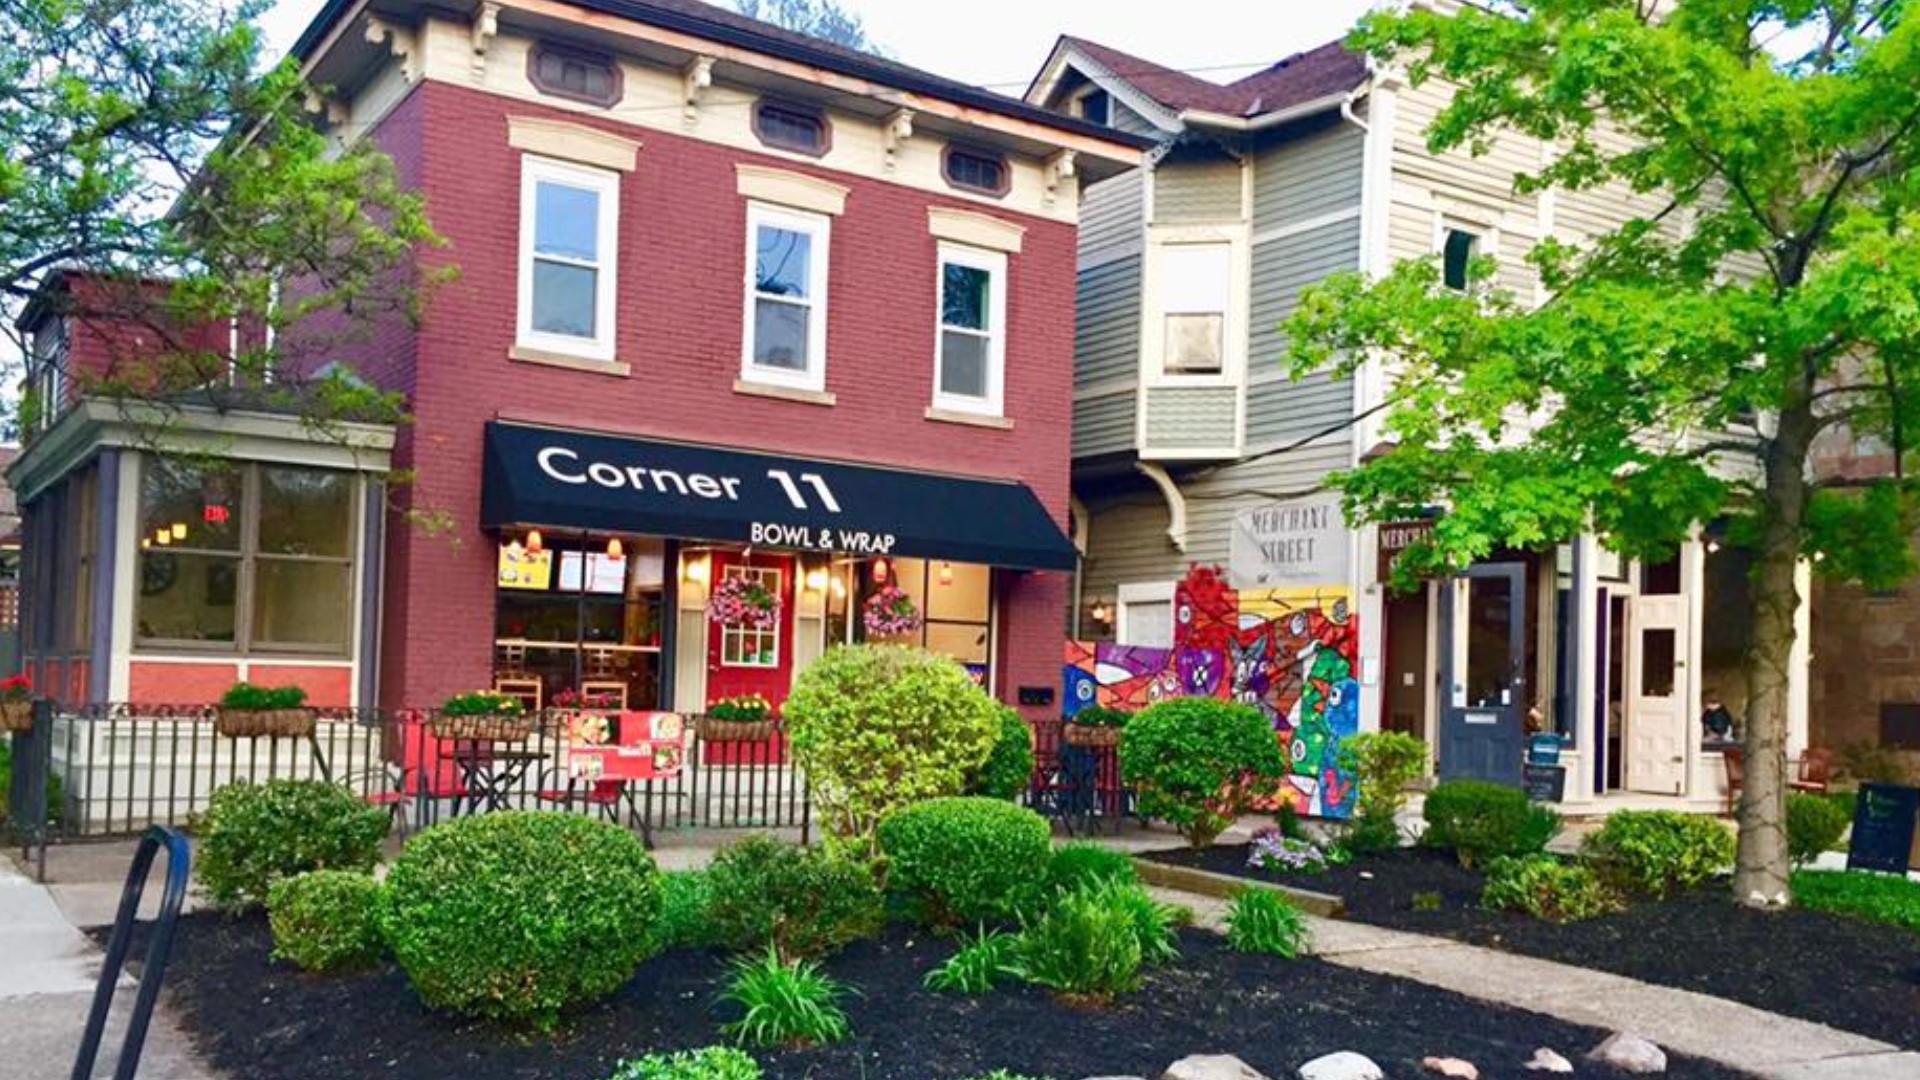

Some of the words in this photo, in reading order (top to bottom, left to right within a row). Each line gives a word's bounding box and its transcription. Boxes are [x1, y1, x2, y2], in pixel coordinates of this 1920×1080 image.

[537, 446, 740, 500] Corner
[767, 469, 841, 512] 11
[1252, 505, 1329, 533] MERCHANT
[751, 521, 813, 548] BOWL
[819, 528, 833, 549] &
[839, 529, 895, 553] WRAP
[1260, 537, 1314, 564] STREET
